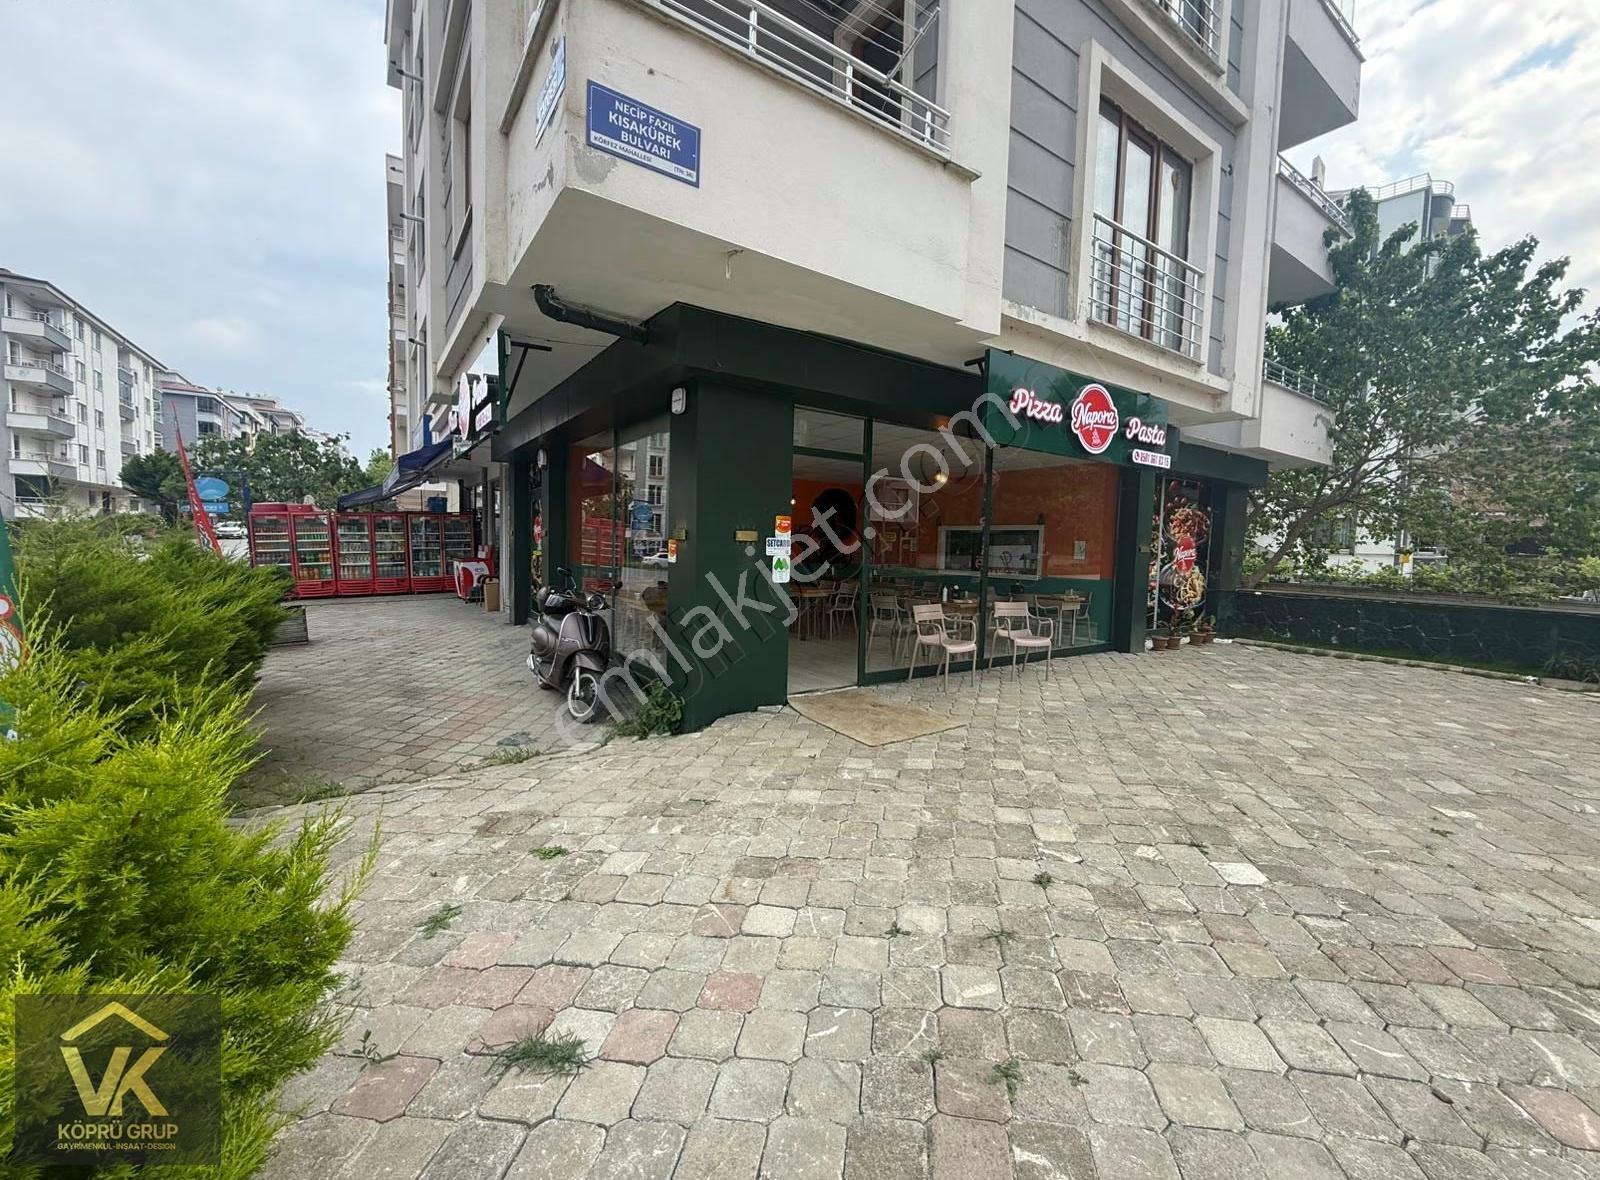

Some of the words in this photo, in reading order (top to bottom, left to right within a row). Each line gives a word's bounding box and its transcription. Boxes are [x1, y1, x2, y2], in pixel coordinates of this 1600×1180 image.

[608, 110, 681, 151] KISAKÜREK
[615, 100, 647, 119] NECİP
[649, 115, 676, 135] FAZIL
[621, 130, 671, 159] BULVARI
[1010, 388, 1063, 423] Pizza
[1074, 402, 1117, 430] Napora
[1125, 417, 1166, 446] Pasta
